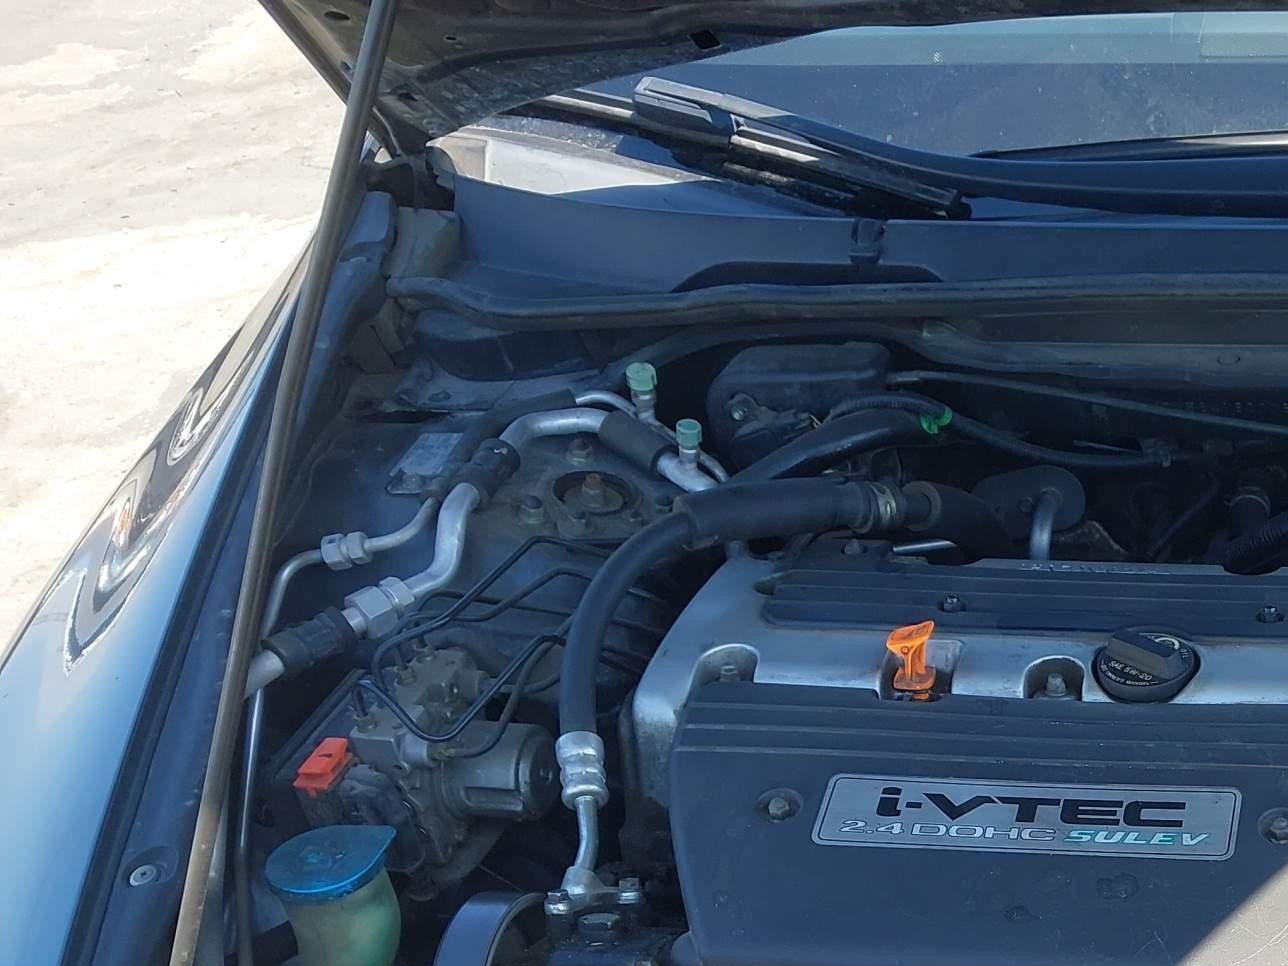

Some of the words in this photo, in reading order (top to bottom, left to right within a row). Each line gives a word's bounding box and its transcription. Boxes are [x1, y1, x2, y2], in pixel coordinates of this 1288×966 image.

[1108, 660, 1125, 670] SAE
[1123, 666, 1153, 681] 5W-20
[876, 786, 1186, 828] i-VTEC
[839, 820, 905, 835] 2.4
[910, 822, 1057, 842] DOHC
[1064, 829, 1210, 847] SULEV
